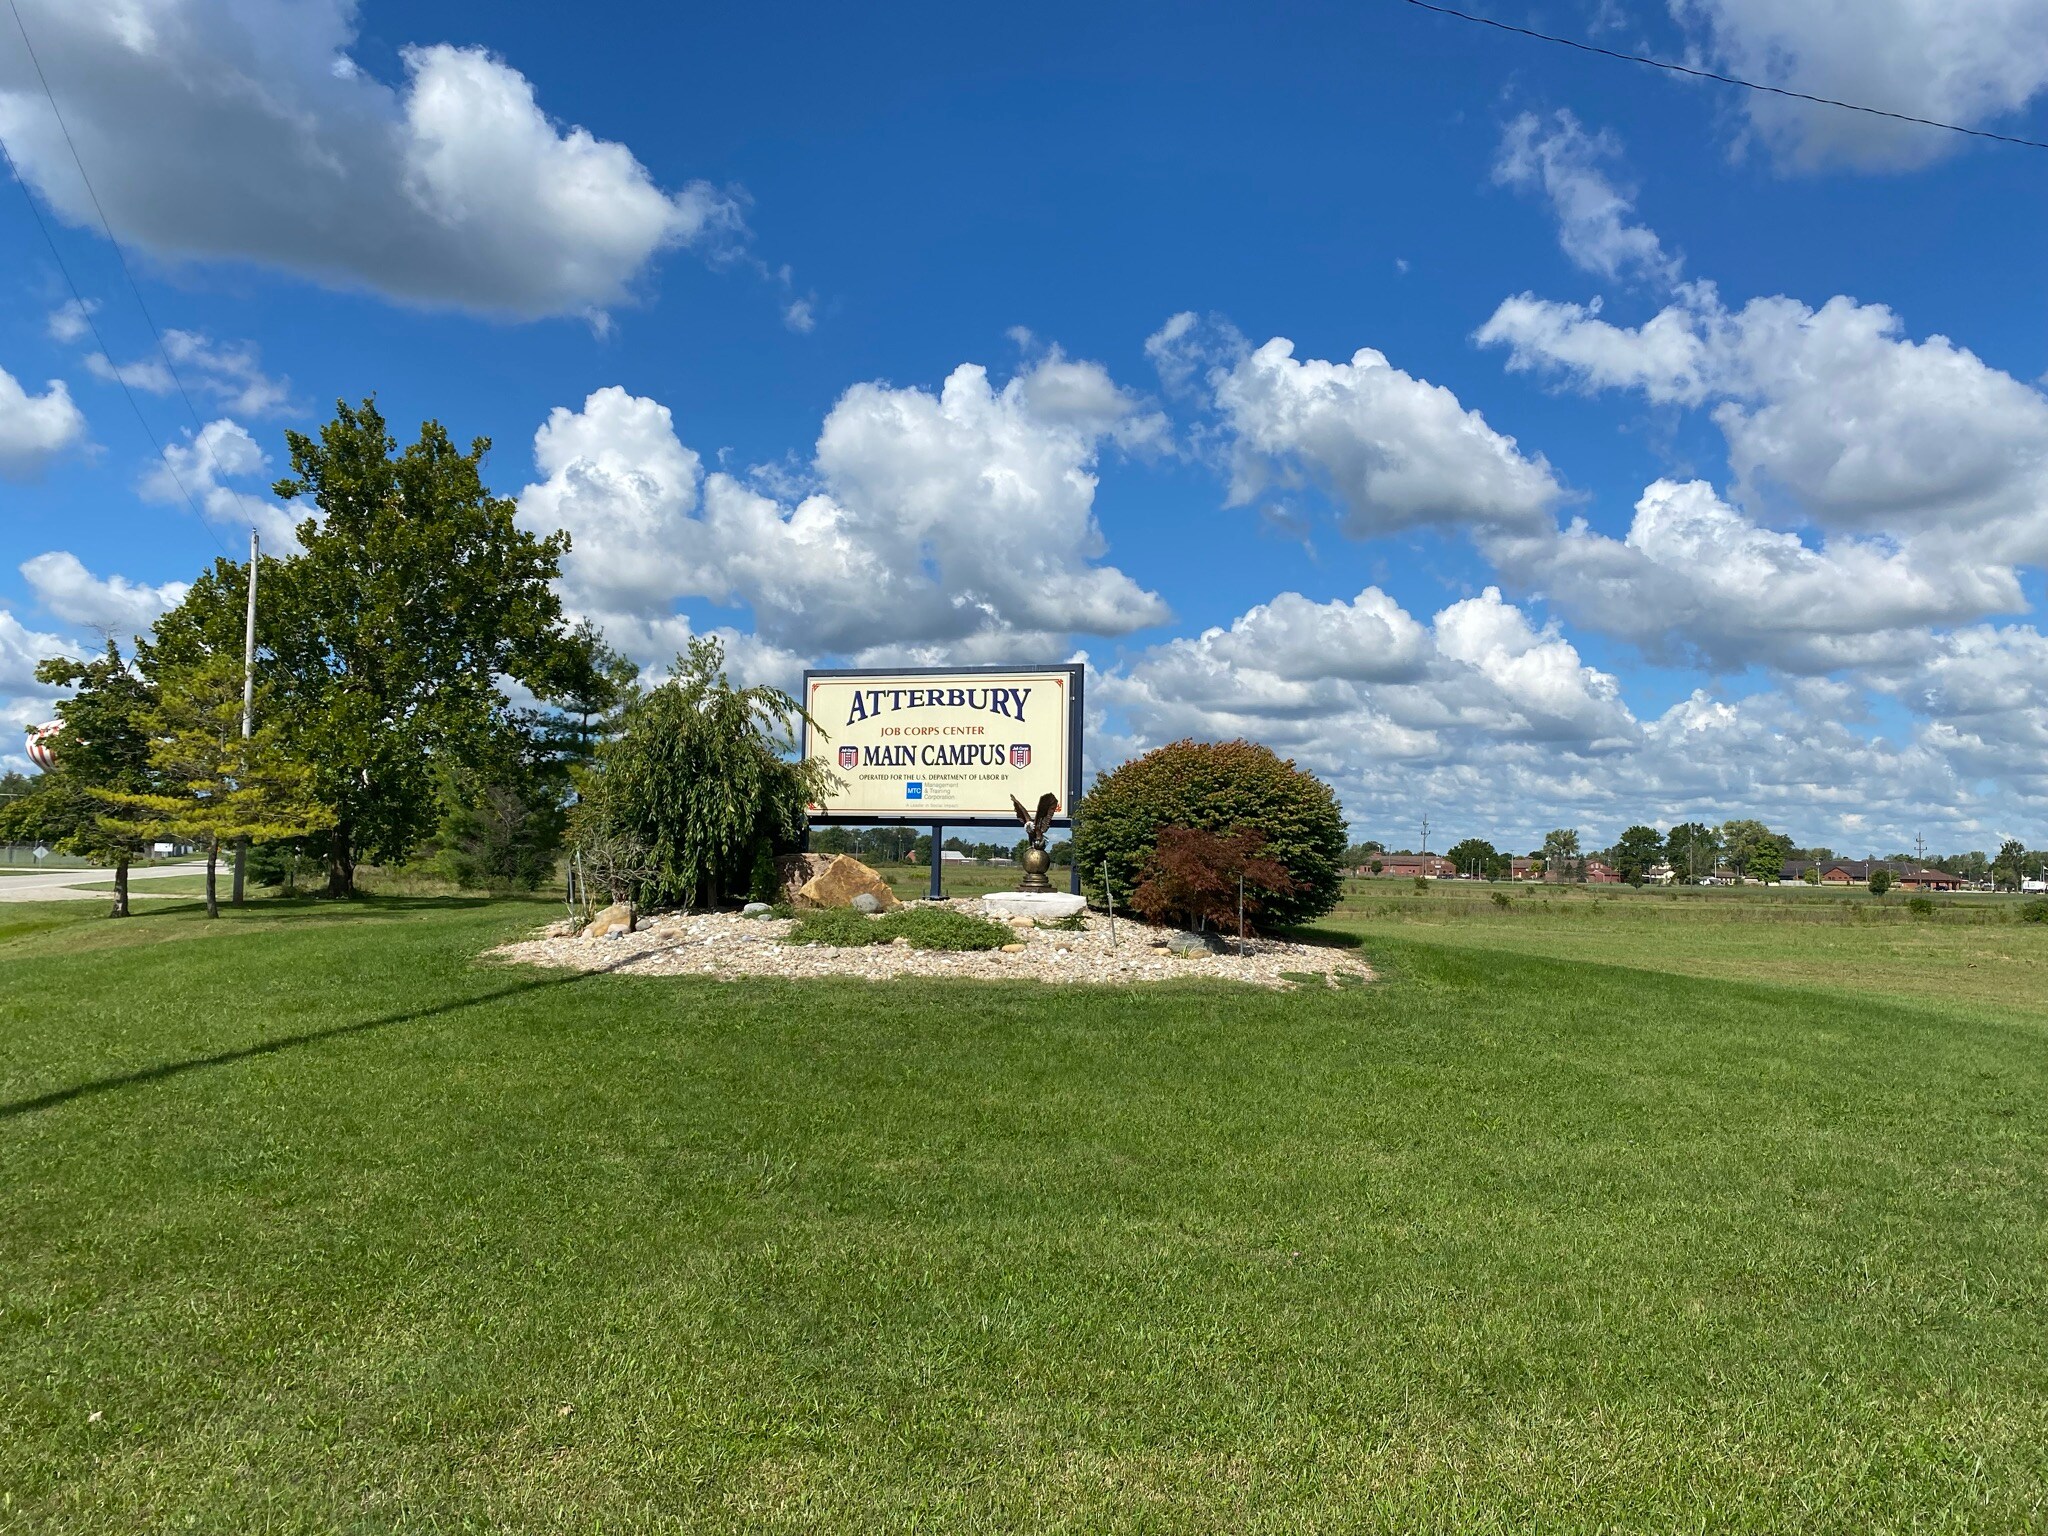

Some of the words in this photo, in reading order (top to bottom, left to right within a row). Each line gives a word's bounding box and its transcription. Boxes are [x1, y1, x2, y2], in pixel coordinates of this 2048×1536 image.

[846, 688, 1031, 726] ATTERBURY
[880, 727, 900, 737] JOB
[904, 727, 940, 736] CORPS
[942, 726, 984, 735] CENTER
[863, 745, 917, 766] MAIN
[922, 744, 1006, 766] CAMPUS
